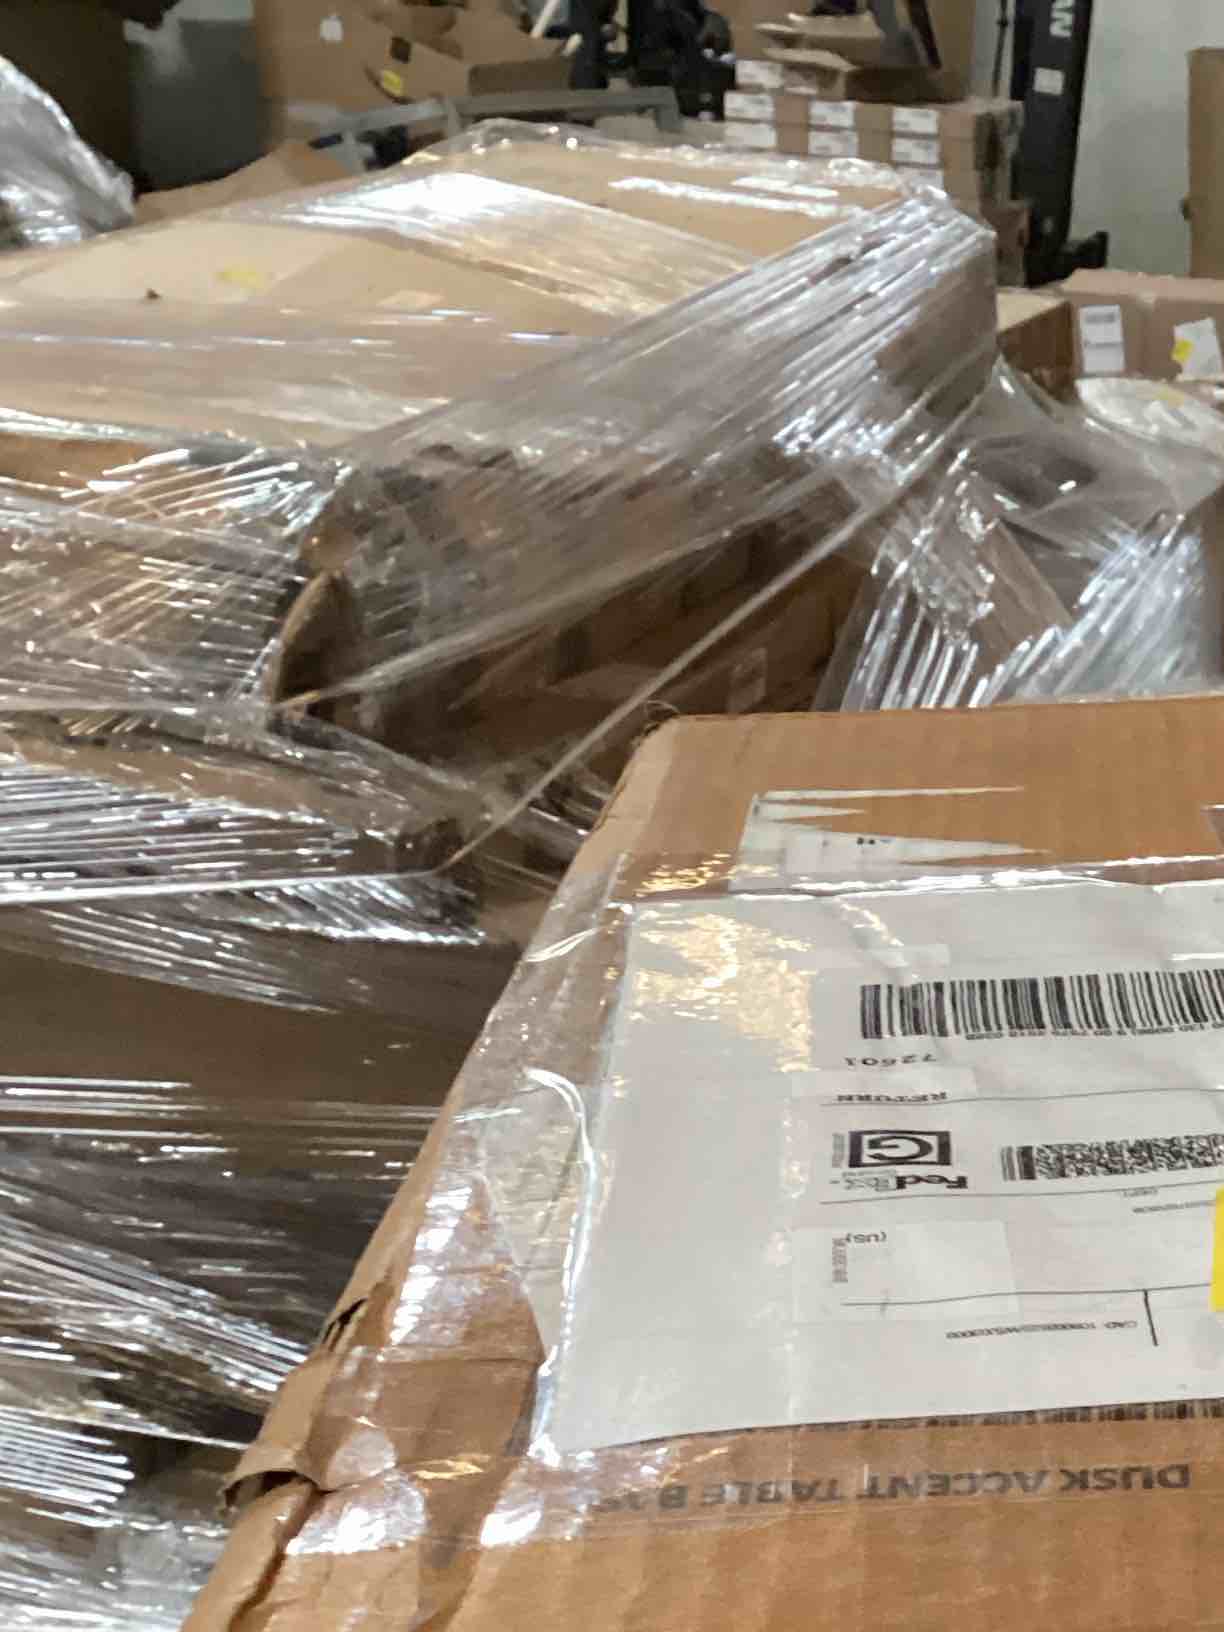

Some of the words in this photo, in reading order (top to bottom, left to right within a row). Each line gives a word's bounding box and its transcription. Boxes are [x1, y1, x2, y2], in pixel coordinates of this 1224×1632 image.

[702, 1478, 842, 1508] TABLE
[854, 1468, 1050, 1501] ACCENT
[1059, 1463, 1192, 1493] DUSK
